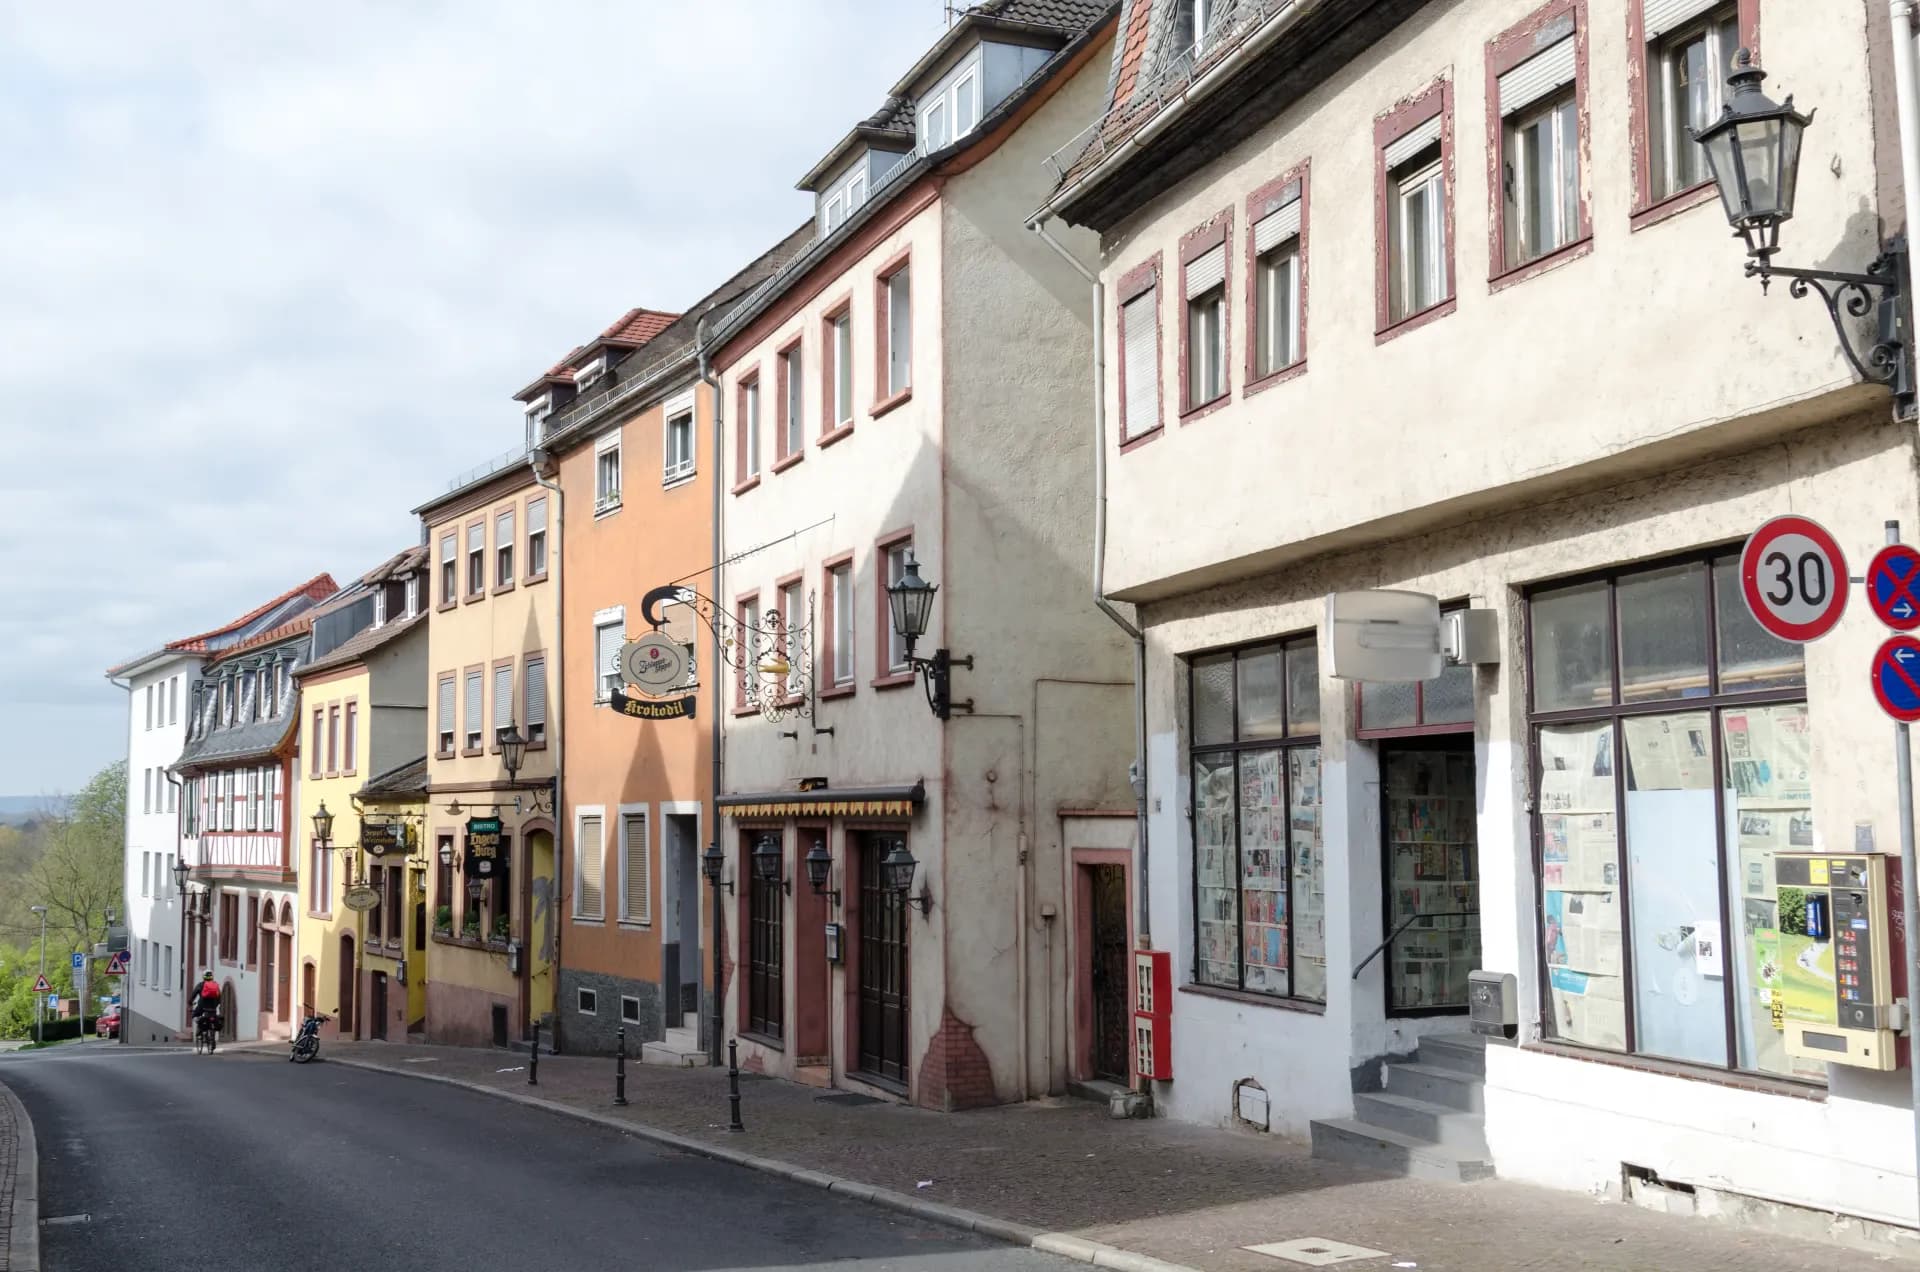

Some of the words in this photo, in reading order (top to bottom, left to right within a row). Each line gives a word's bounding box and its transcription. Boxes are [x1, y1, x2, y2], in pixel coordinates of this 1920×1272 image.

[1765, 551, 1826, 606] 30
[624, 701, 684, 716] Krokodil
[74, 955, 82, 966] P
